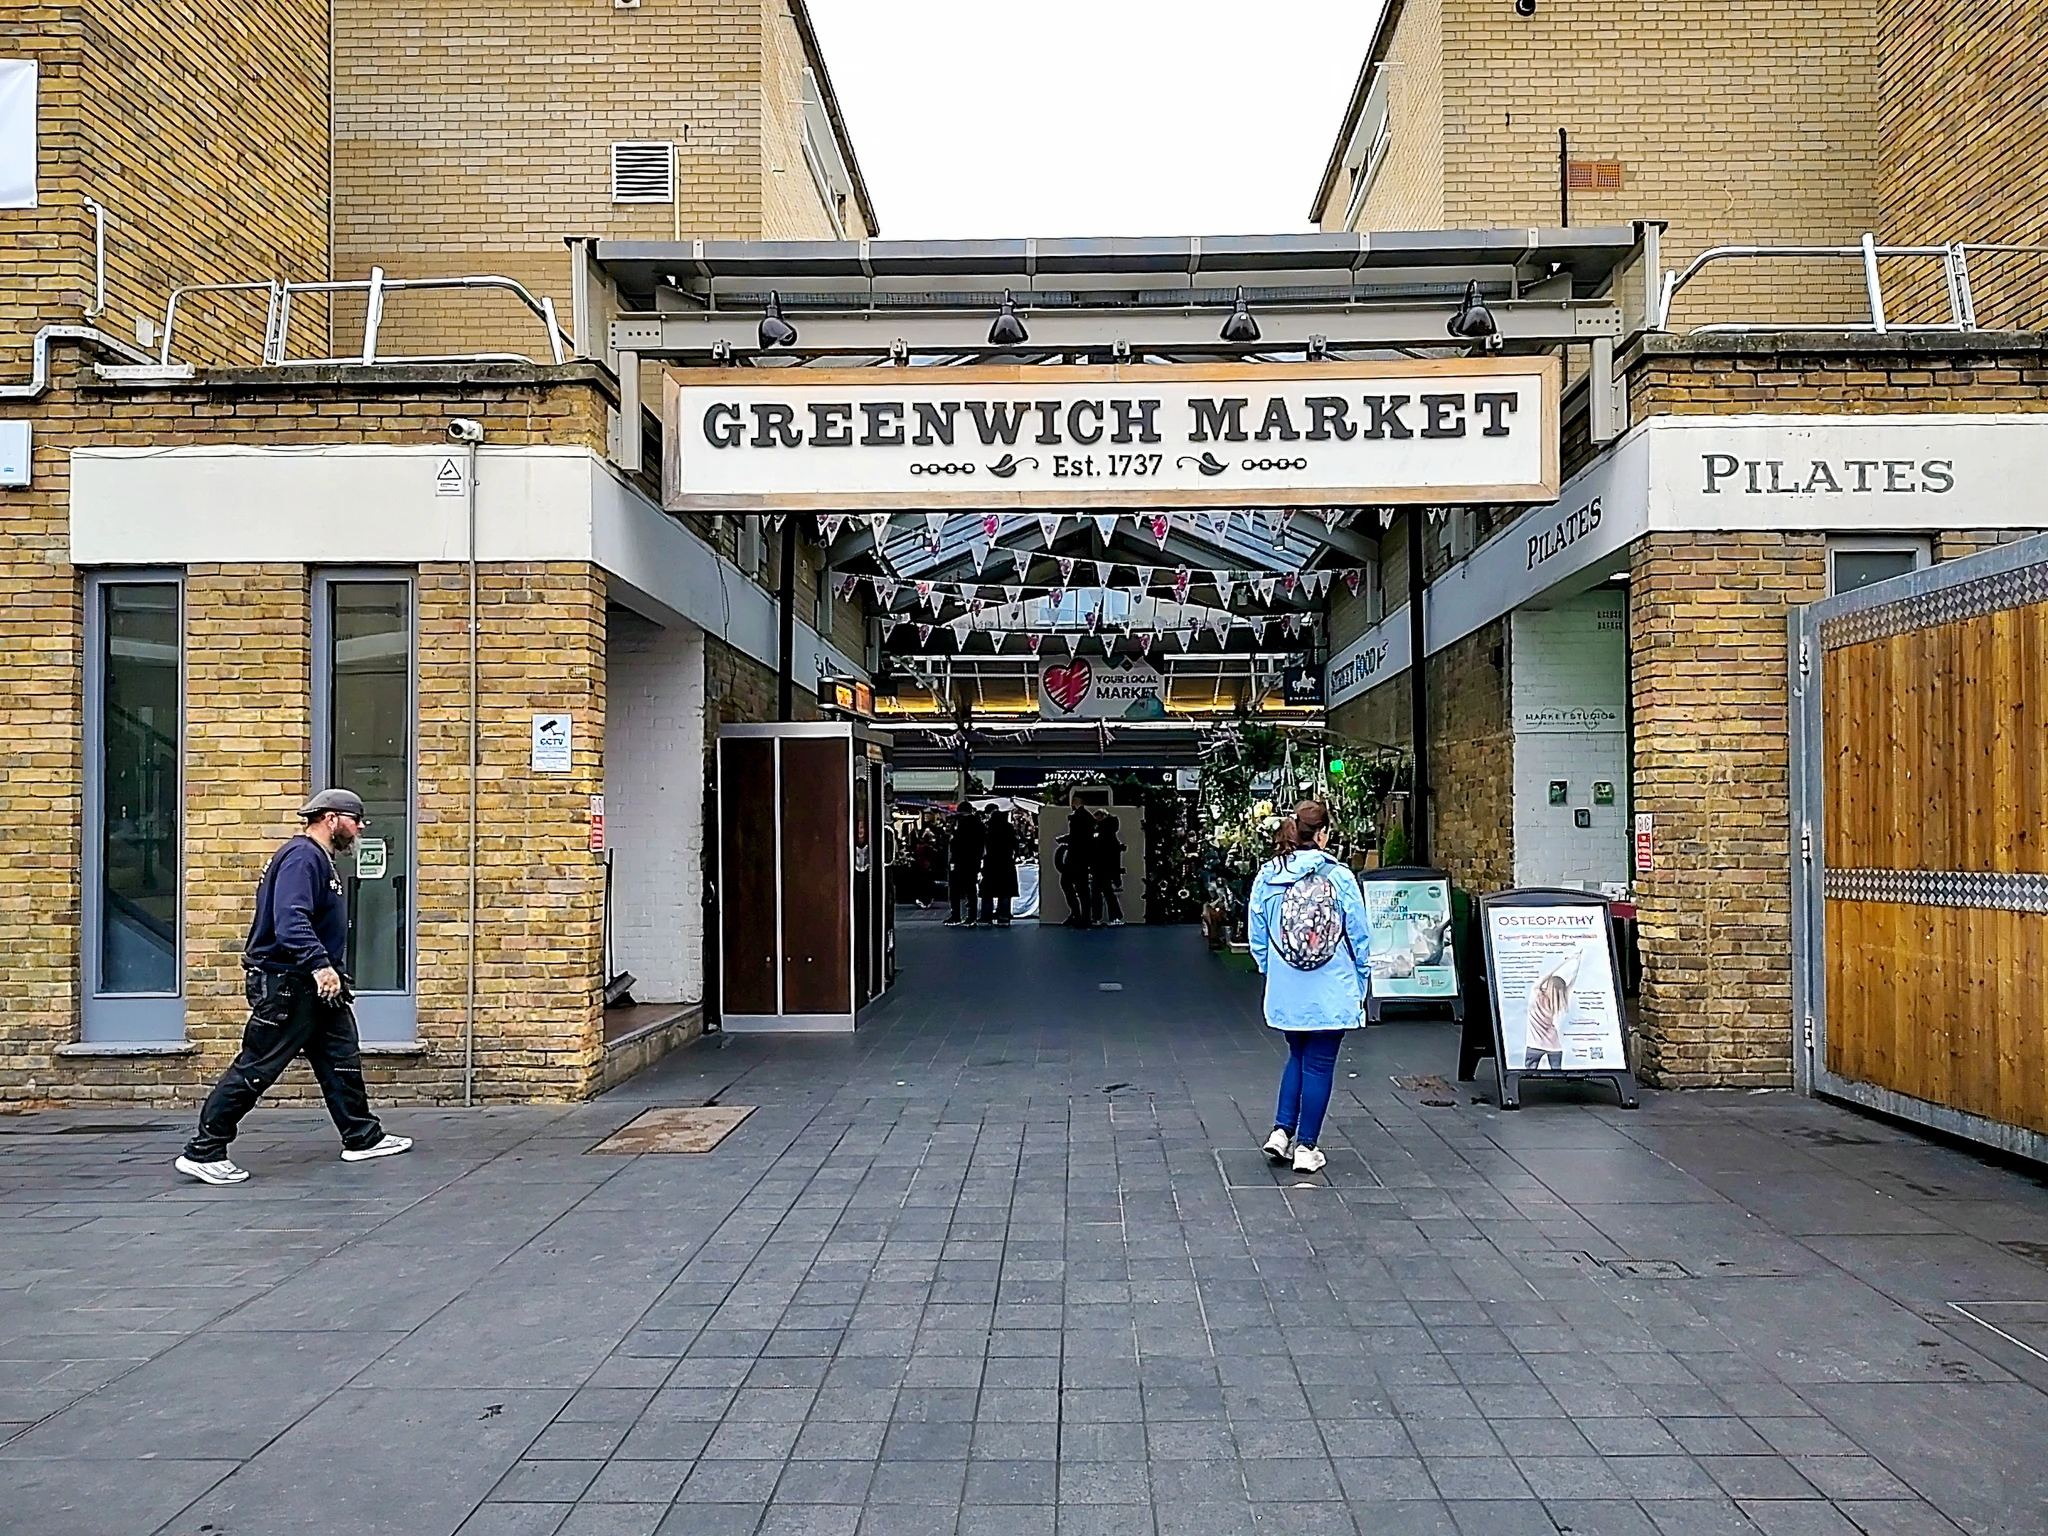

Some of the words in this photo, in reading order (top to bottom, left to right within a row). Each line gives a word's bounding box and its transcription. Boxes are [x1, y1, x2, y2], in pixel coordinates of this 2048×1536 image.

[702, 399, 1163, 450] GREENWICH
[1188, 391, 1519, 442] MARKET
[1052, 455, 1101, 478] Est.
[1108, 454, 1163, 478] 1737
[1702, 454, 1955, 494] PILATES
[1526, 495, 1603, 571] PILATES
[1096, 675, 1124, 684] YOUR
[1125, 675, 1158, 684] LOCAL
[1096, 686, 1158, 699] MARKET
[1525, 713, 1567, 721] MARKET
[540, 738, 564, 746] CCTV
[360, 850, 383, 864] ADT
[1498, 915, 1594, 926] OSTEOPATHY
